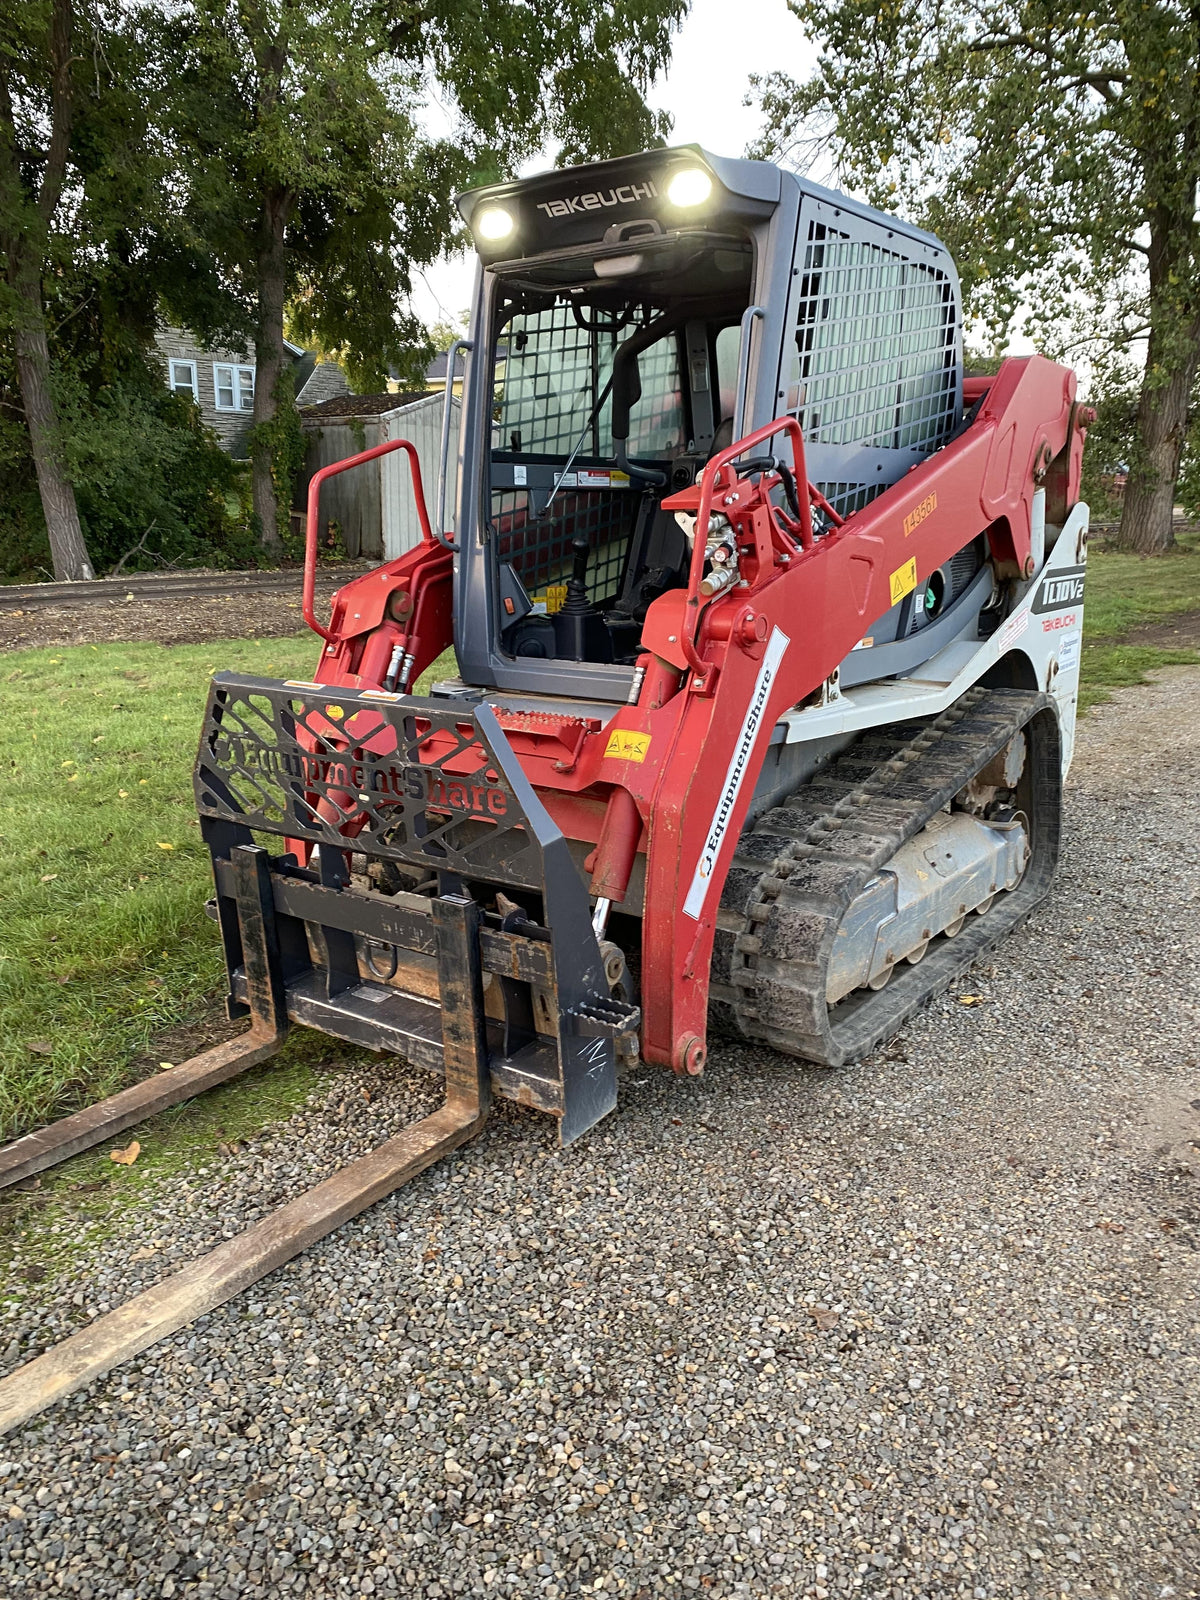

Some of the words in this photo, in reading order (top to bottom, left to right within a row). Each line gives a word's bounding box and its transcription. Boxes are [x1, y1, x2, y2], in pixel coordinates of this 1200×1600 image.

[537, 182, 658, 217] TAKEUCHI
[904, 491, 937, 534] 143567
[1042, 573, 1085, 605] TL10V2
[1042, 614, 1076, 633] TAKEUCHI
[708, 670, 771, 853] EquipmentShare
